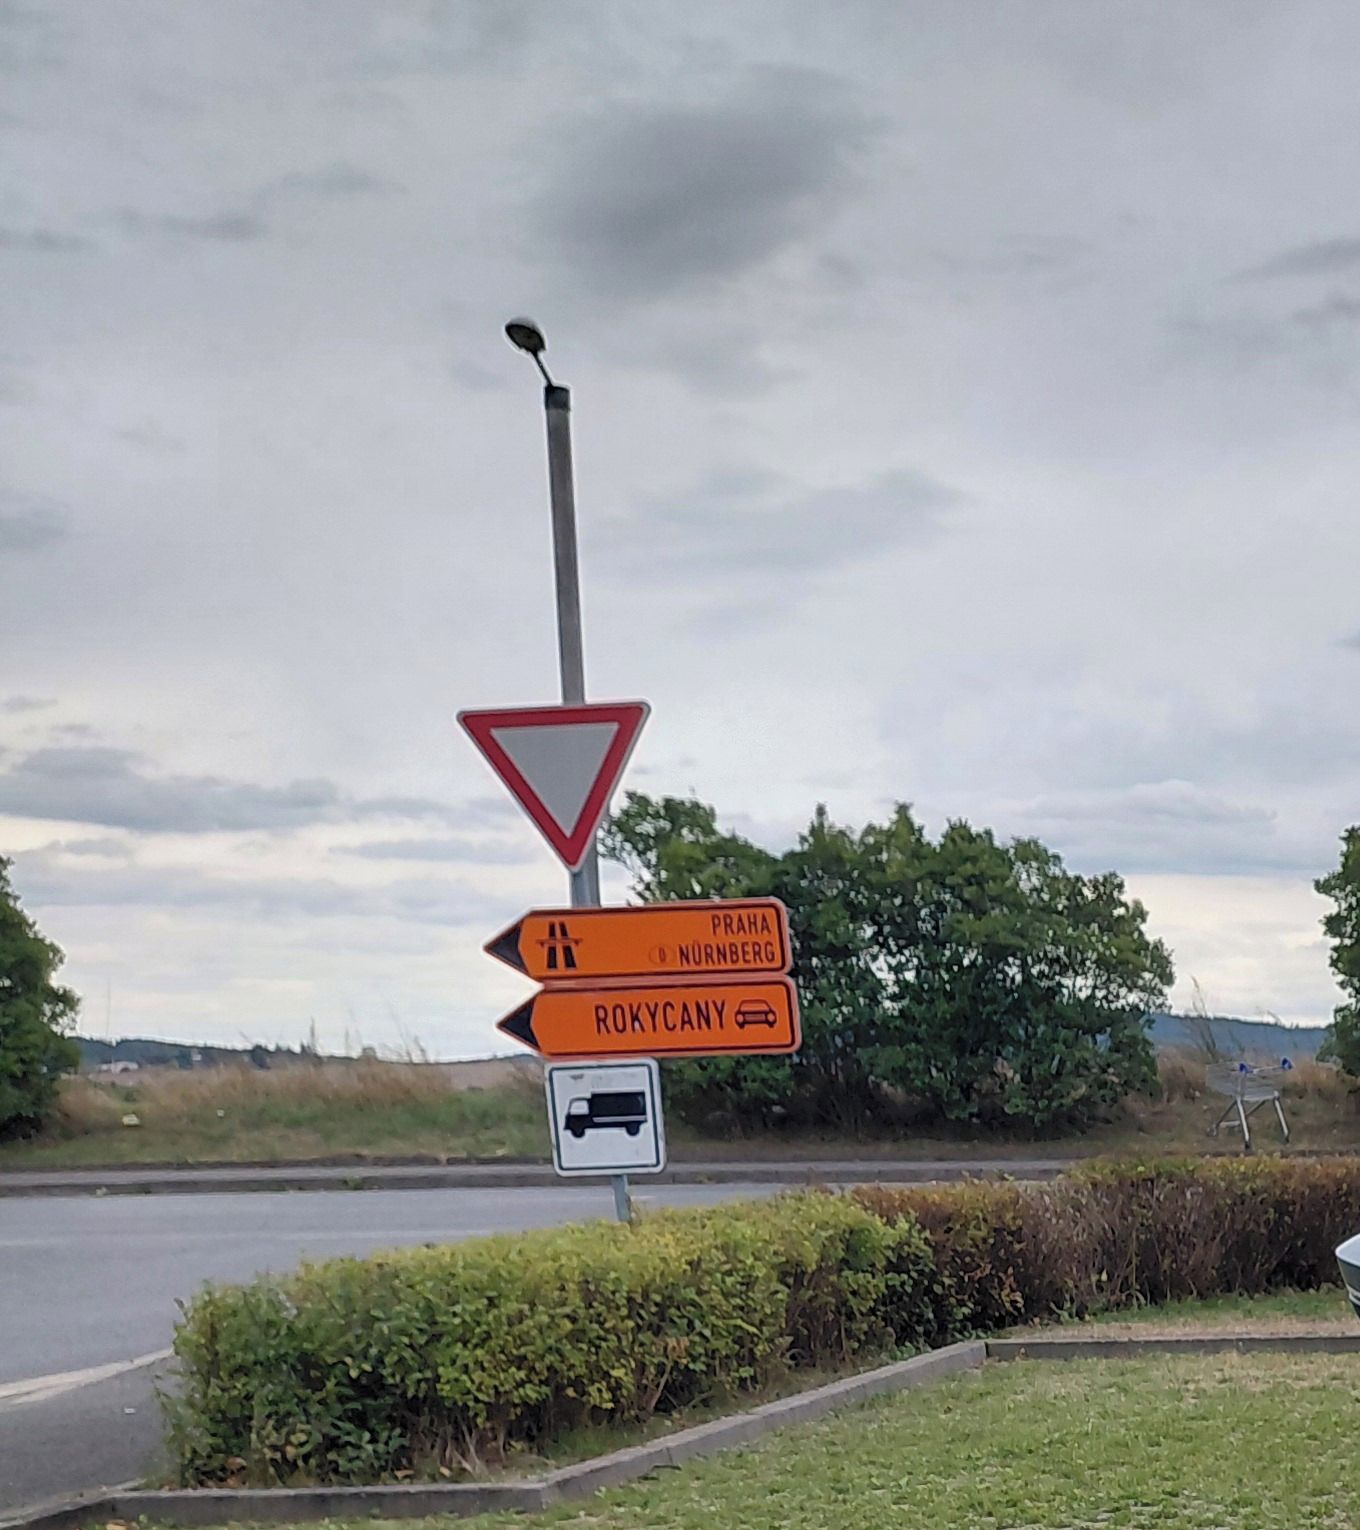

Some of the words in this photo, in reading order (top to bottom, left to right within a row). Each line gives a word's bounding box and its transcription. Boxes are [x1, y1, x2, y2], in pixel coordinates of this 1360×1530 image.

[711, 913, 770, 935] PRAHA
[679, 940, 775, 966] NÜRNBERG
[595, 1000, 726, 1034] ROKYCANY
